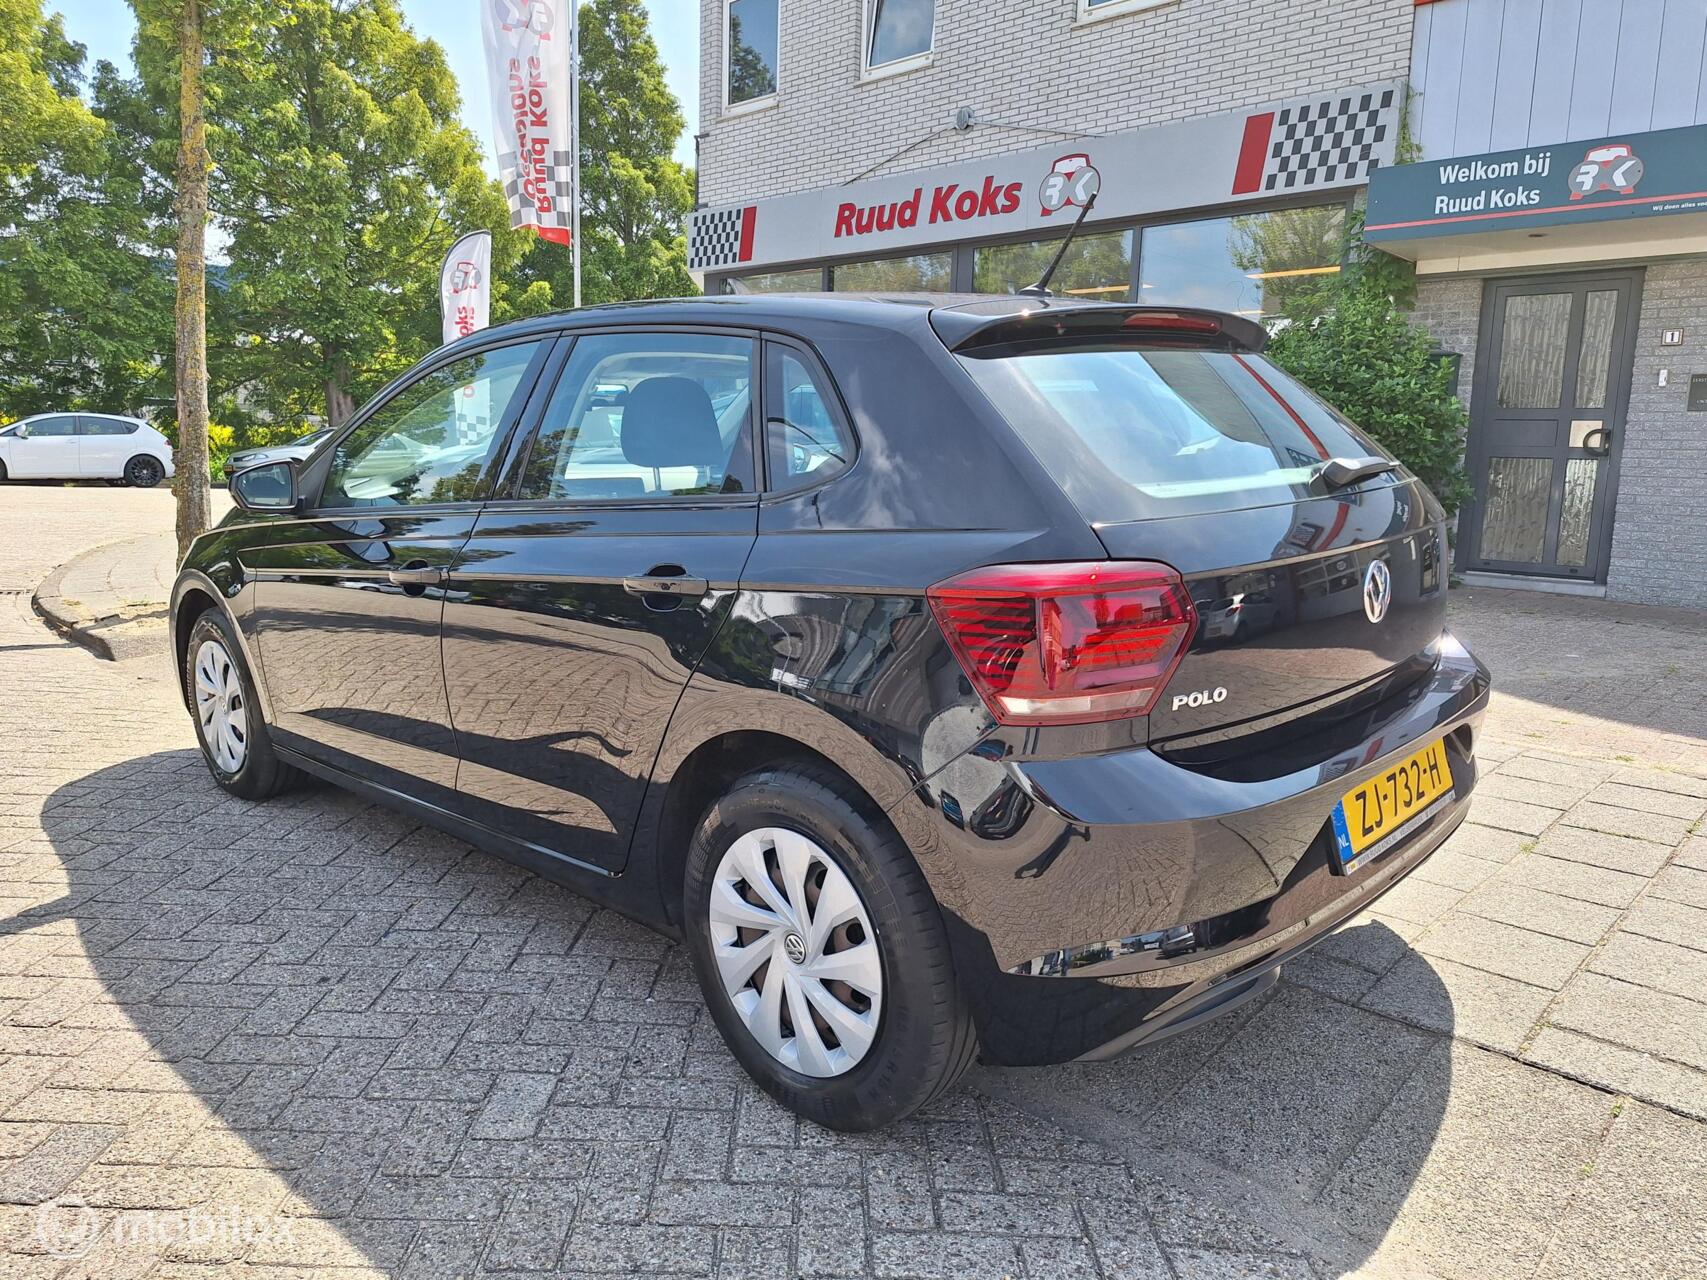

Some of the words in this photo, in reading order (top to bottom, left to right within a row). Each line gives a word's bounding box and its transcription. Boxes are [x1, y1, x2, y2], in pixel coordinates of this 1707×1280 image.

[1439, 162, 1519, 185] Welkom
[1524, 152, 1551, 177] bij
[834, 187, 923, 238] Ruud
[929, 175, 1023, 224] Koks
[1434, 189, 1487, 214] Ruud
[1490, 185, 1540, 209] Koks
[1172, 686, 1228, 712] POLO
[1355, 747, 1442, 837] ZJ-732-H
[1337, 832, 1350, 849] NL
